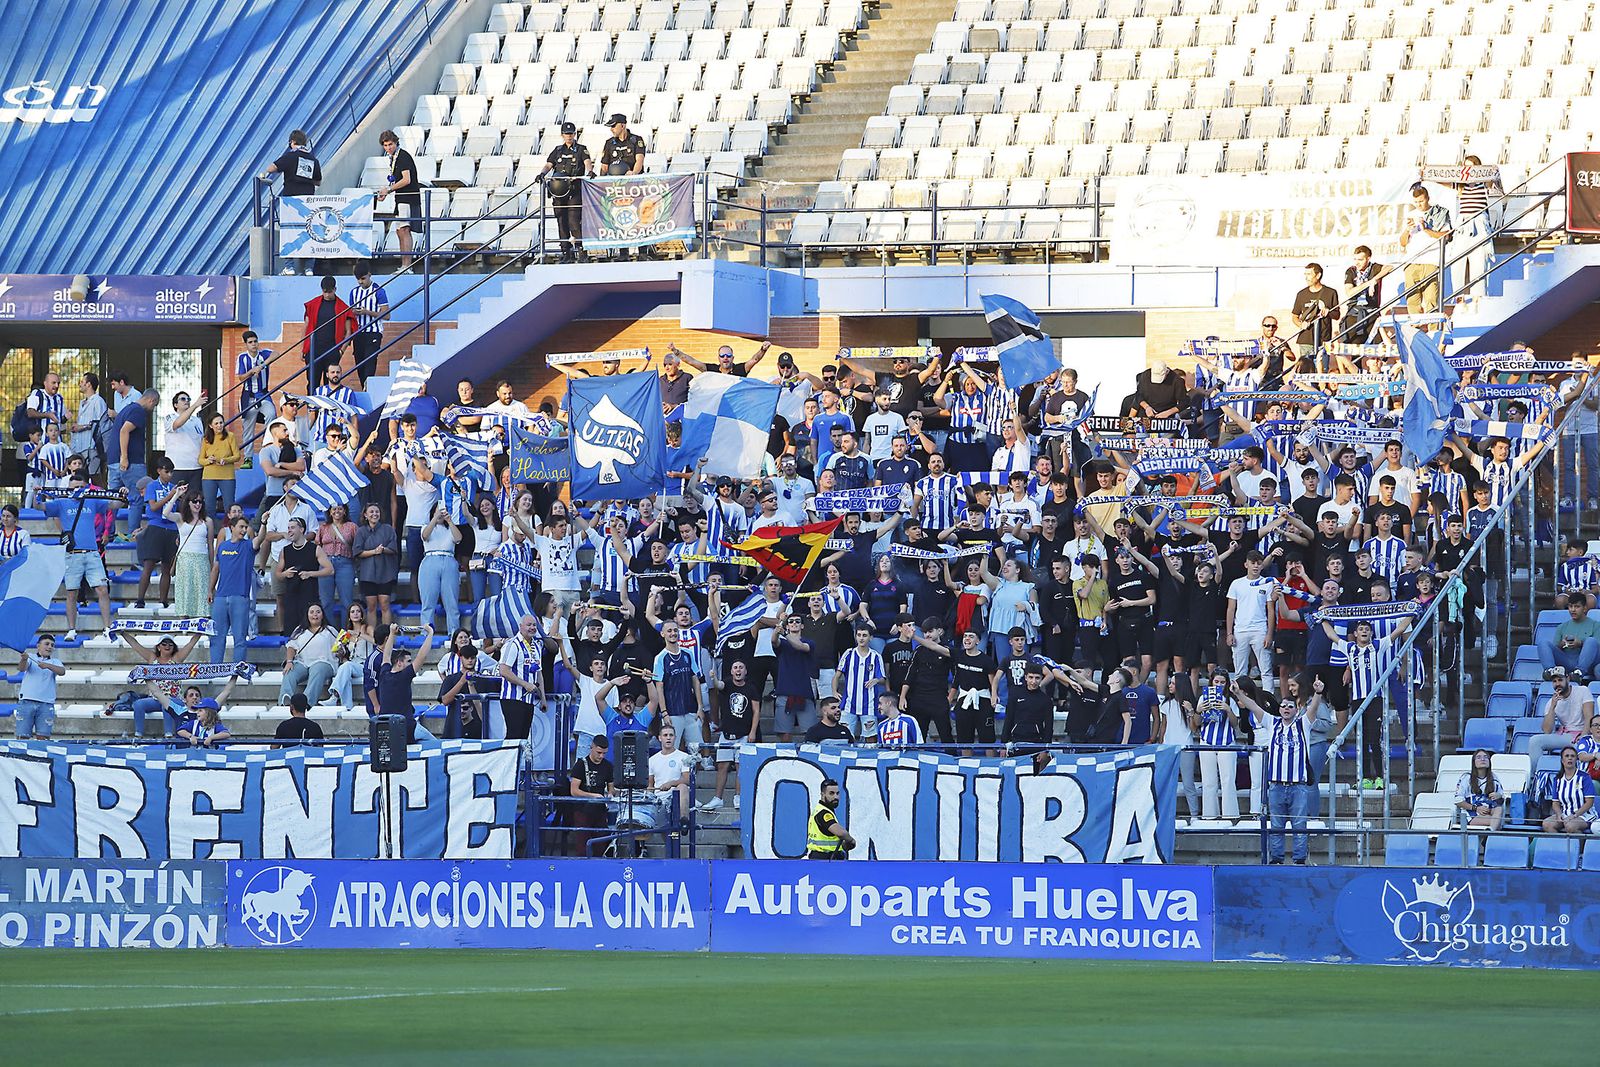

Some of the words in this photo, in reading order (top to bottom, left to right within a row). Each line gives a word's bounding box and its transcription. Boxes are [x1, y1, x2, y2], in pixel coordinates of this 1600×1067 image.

[605, 182, 671, 199] PELOTON
[598, 219, 676, 241] PANSARCO
[53, 288, 73, 301] alt
[155, 288, 190, 301] alter
[53, 301, 115, 314] enersun
[155, 302, 217, 315] enersun
[1495, 360, 1565, 370] RECREATIVO
[1486, 385, 1540, 397] Recreativo
[876, 426, 888, 434] HH
[1087, 417, 1120, 431] RENTE
[582, 420, 644, 458] ULTRAS
[1138, 457, 1200, 473] RECREATIVO
[815, 498, 902, 512] RECREATIVO
[1007, 660, 1028, 670] JUST
[0, 745, 521, 860] FRENTE
[751, 755, 1167, 864] ONUBA
[25, 860, 203, 904] MARTÍN
[329, 878, 546, 929] ATRACCIONES
[554, 881, 594, 929] LA
[602, 877, 695, 930] CINTA
[724, 873, 993, 927] Autoparts
[1011, 876, 1199, 922] Huelva
[44, 905, 219, 949] PINZÓN
[1392, 908, 1570, 953] Chiguagua
[890, 924, 968, 945] CREA
[975, 925, 1014, 946] TU
[1016, 926, 1202, 950] FRANQUICIA
